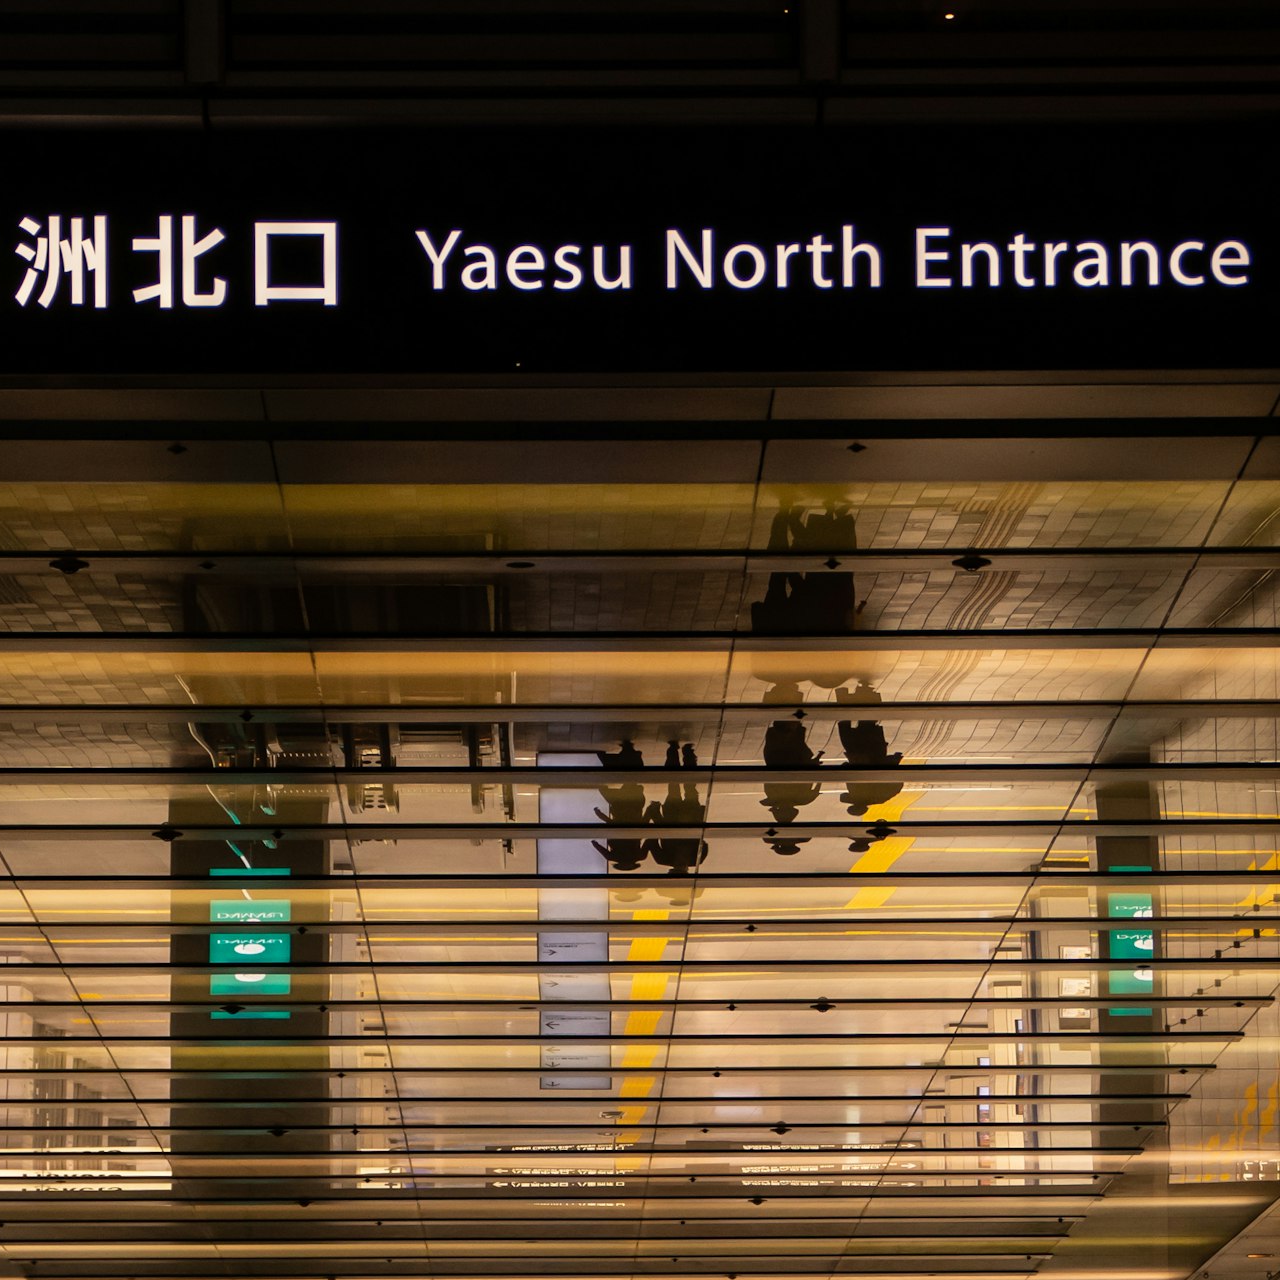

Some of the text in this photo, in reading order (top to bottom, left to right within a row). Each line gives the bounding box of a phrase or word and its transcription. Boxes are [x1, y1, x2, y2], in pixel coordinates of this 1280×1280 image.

[416, 225, 1251, 291] Yaesu North Entrance
